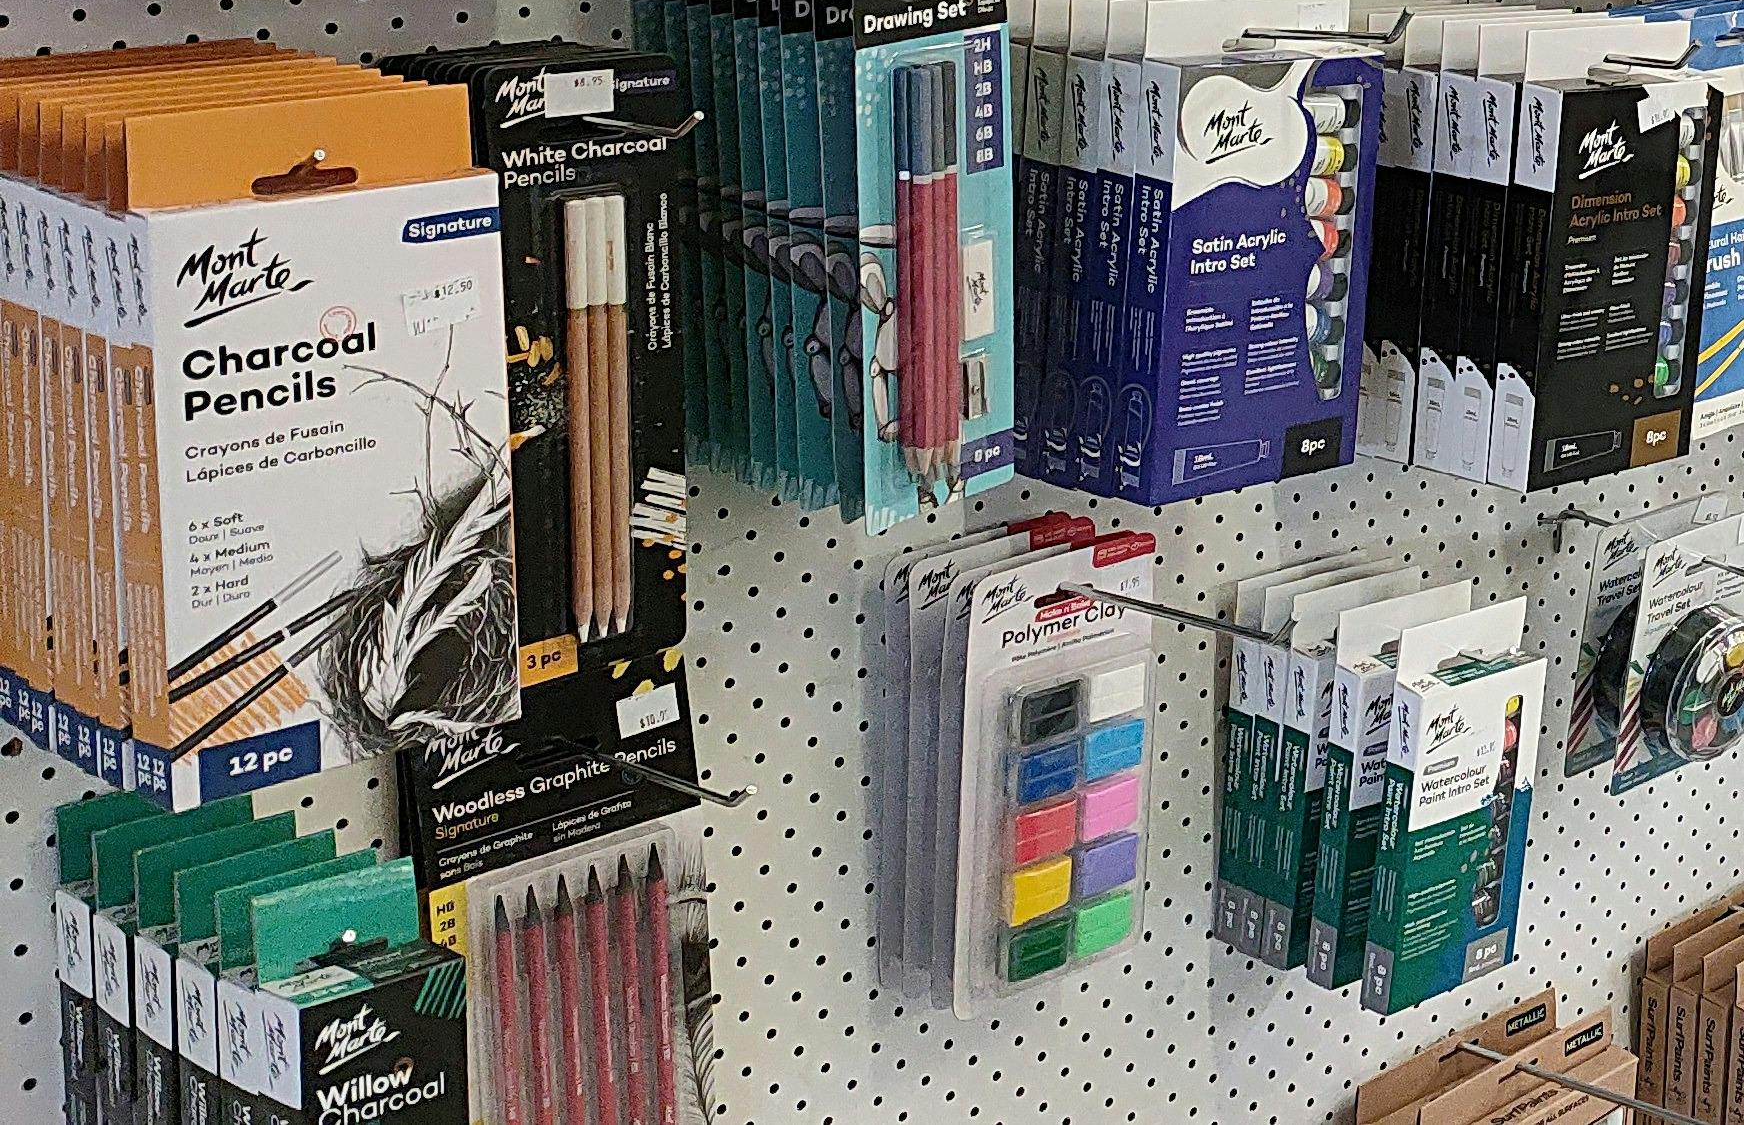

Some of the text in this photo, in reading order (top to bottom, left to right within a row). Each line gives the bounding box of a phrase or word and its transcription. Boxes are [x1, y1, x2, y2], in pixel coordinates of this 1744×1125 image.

[864, 0, 966, 32] Drawing Set
[974, 60, 992, 74] HB
[975, 82, 991, 96] 2B
[1205, 102, 1251, 137] Mont
[1579, 119, 1619, 154] Mont
[502, 137, 667, 168] White Charcoal
[504, 166, 576, 189] Pencils
[1571, 190, 1631, 209] Dimension
[408, 215, 492, 239] Signature
[1570, 204, 1663, 230] Acrylic Intro Set
[1192, 228, 1286, 255] Satin Acrylic
[177, 228, 269, 287] Mont
[1191, 254, 1256, 275] Intro Set
[195, 255, 291, 310] Marte
[435, 280, 473, 299] $12.50
[183, 322, 376, 379] Charcoal
[185, 373, 336, 420] Pencils
[186, 421, 345, 460] Crayons de Fusain
[186, 436, 377, 484] Lápices de Carboncillo
[189, 523, 265, 545] Doux Suave
[190, 553, 273, 577] Moyen Medio
[982, 576, 1019, 605] Mont
[1650, 582, 1703, 609] Watercolour
[1001, 603, 1128, 649] Polymer Clay
[526, 651, 561, 669] 3 pc
[230, 746, 293, 776] 12 pc
[432, 738, 676, 823] Woodless Graphite Pencils
[1419, 776, 1490, 808] Paint Intro Set
[1421, 764, 1486, 793] Watercolour
[436, 811, 499, 840] Signature
[315, 1005, 373, 1050] Mont
[1508, 1007, 1545, 1033] METALLIC
[1566, 1026, 1602, 1052] METALLIC
[317, 1069, 412, 1109] Willow
[319, 1074, 446, 1125] Charcoal
